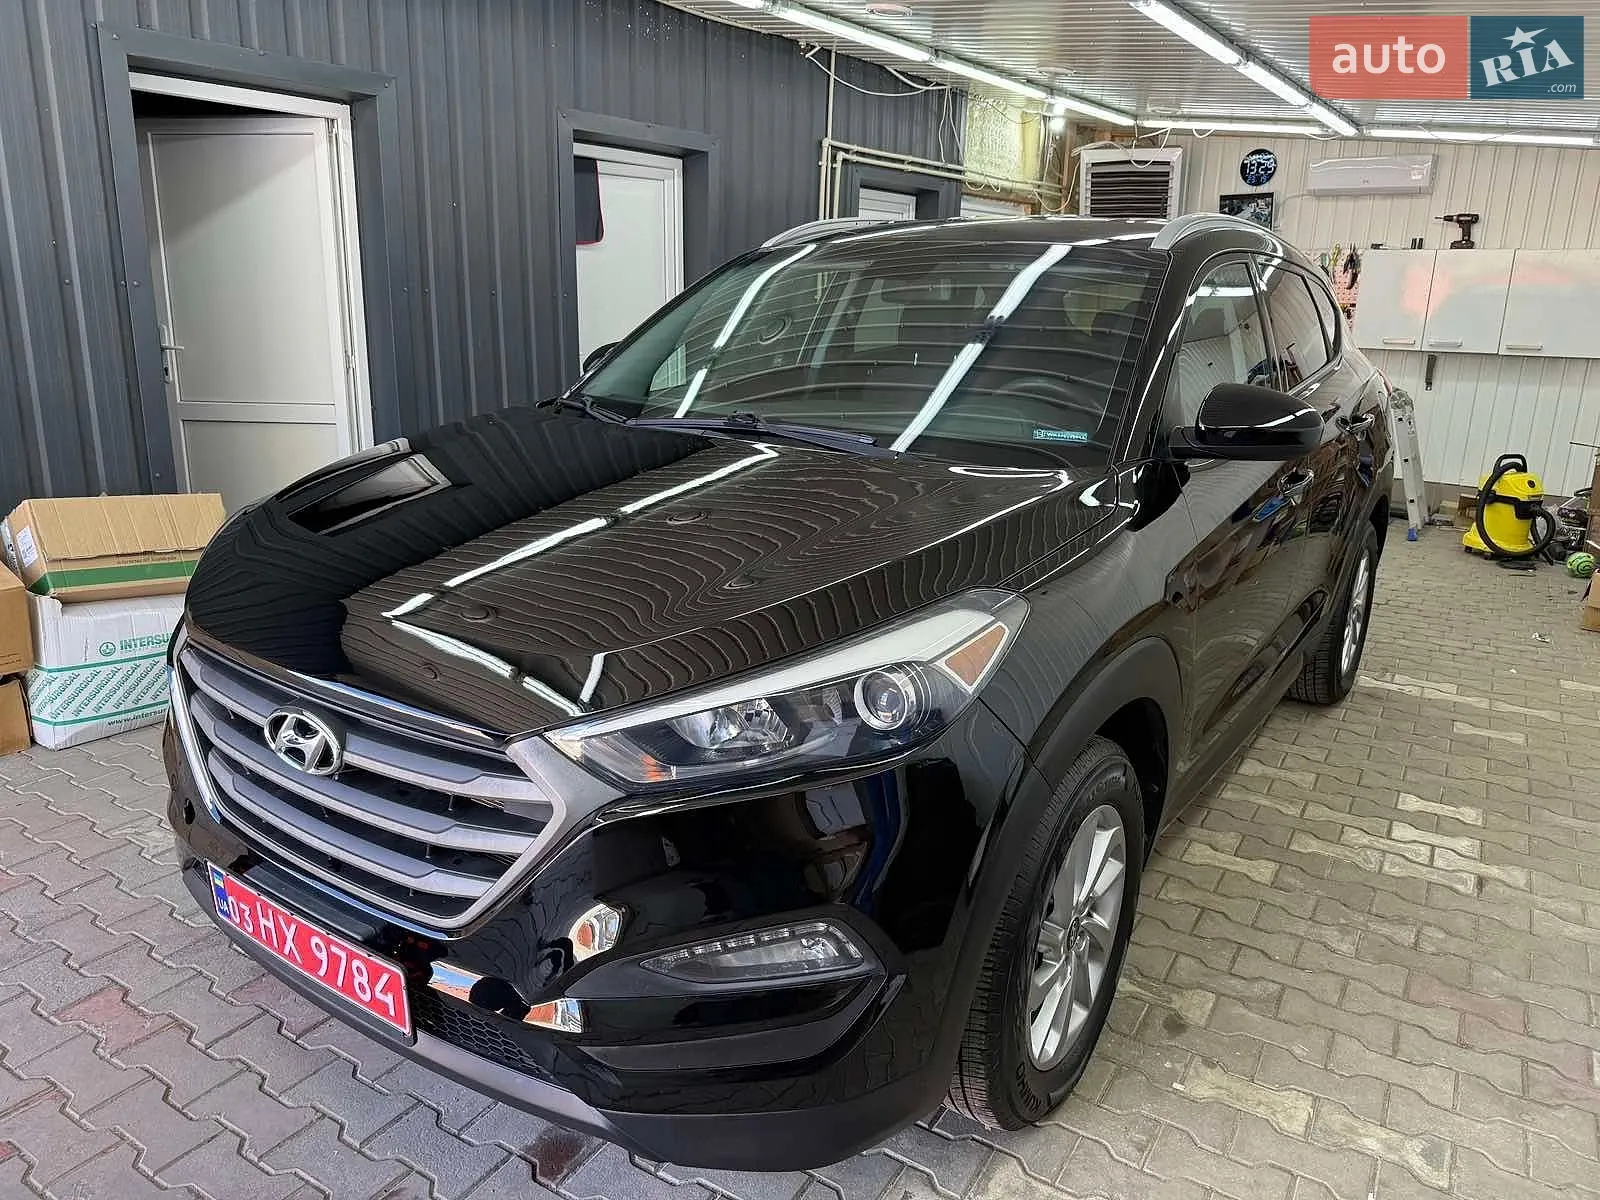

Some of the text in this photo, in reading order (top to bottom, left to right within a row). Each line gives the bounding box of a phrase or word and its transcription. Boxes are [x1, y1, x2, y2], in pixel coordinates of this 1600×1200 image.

[120, 632, 172, 650] INTERSU
[49, 669, 101, 719] INTERSURGICAL
[72, 666, 122, 717] INTERSURGICAL
[92, 663, 141, 713] INTERSURGICAL
[113, 659, 160, 710] INTERSURGICAL
[217, 896, 230, 914] UA
[228, 895, 396, 1017] 03 HX 9784
